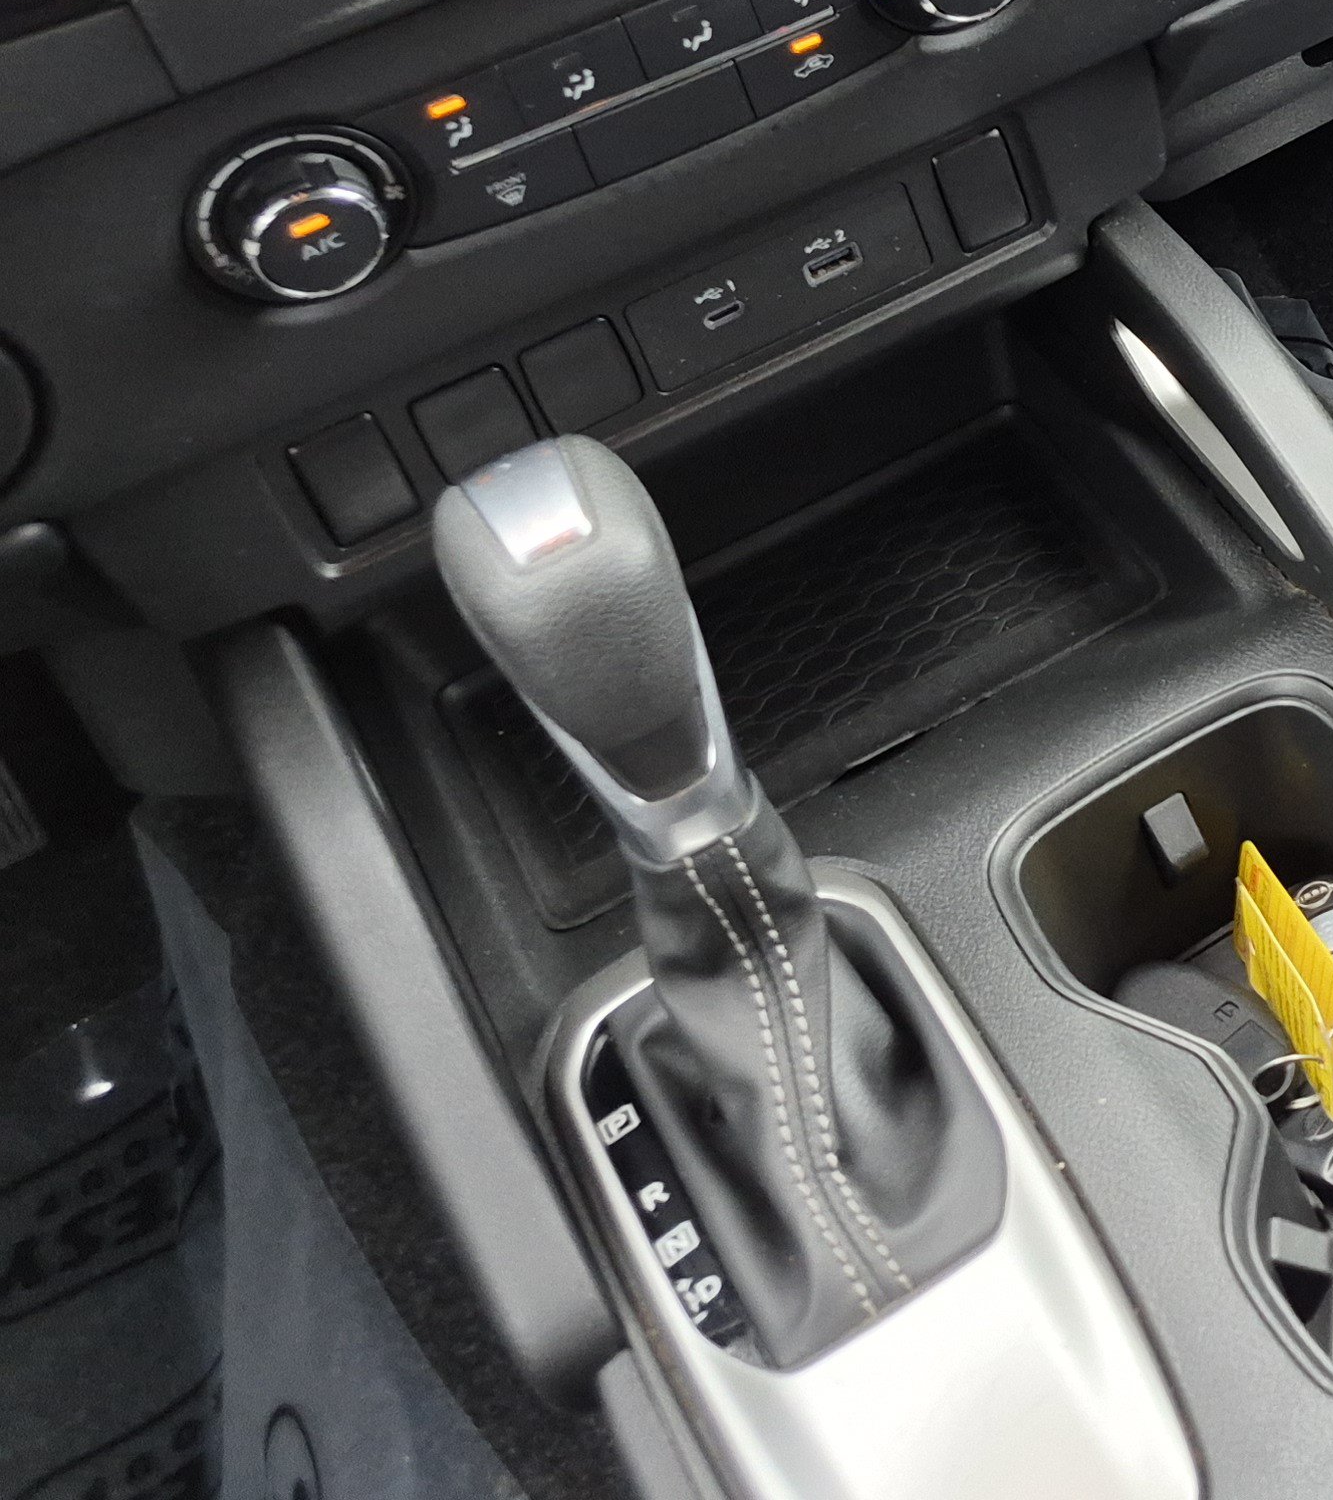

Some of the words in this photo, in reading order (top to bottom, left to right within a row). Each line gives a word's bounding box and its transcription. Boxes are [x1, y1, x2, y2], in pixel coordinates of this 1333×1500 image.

[302, 232, 347, 261] A/C
[834, 228, 846, 243] 2
[638, 1181, 671, 1212] R
[693, 1275, 722, 1304] D
